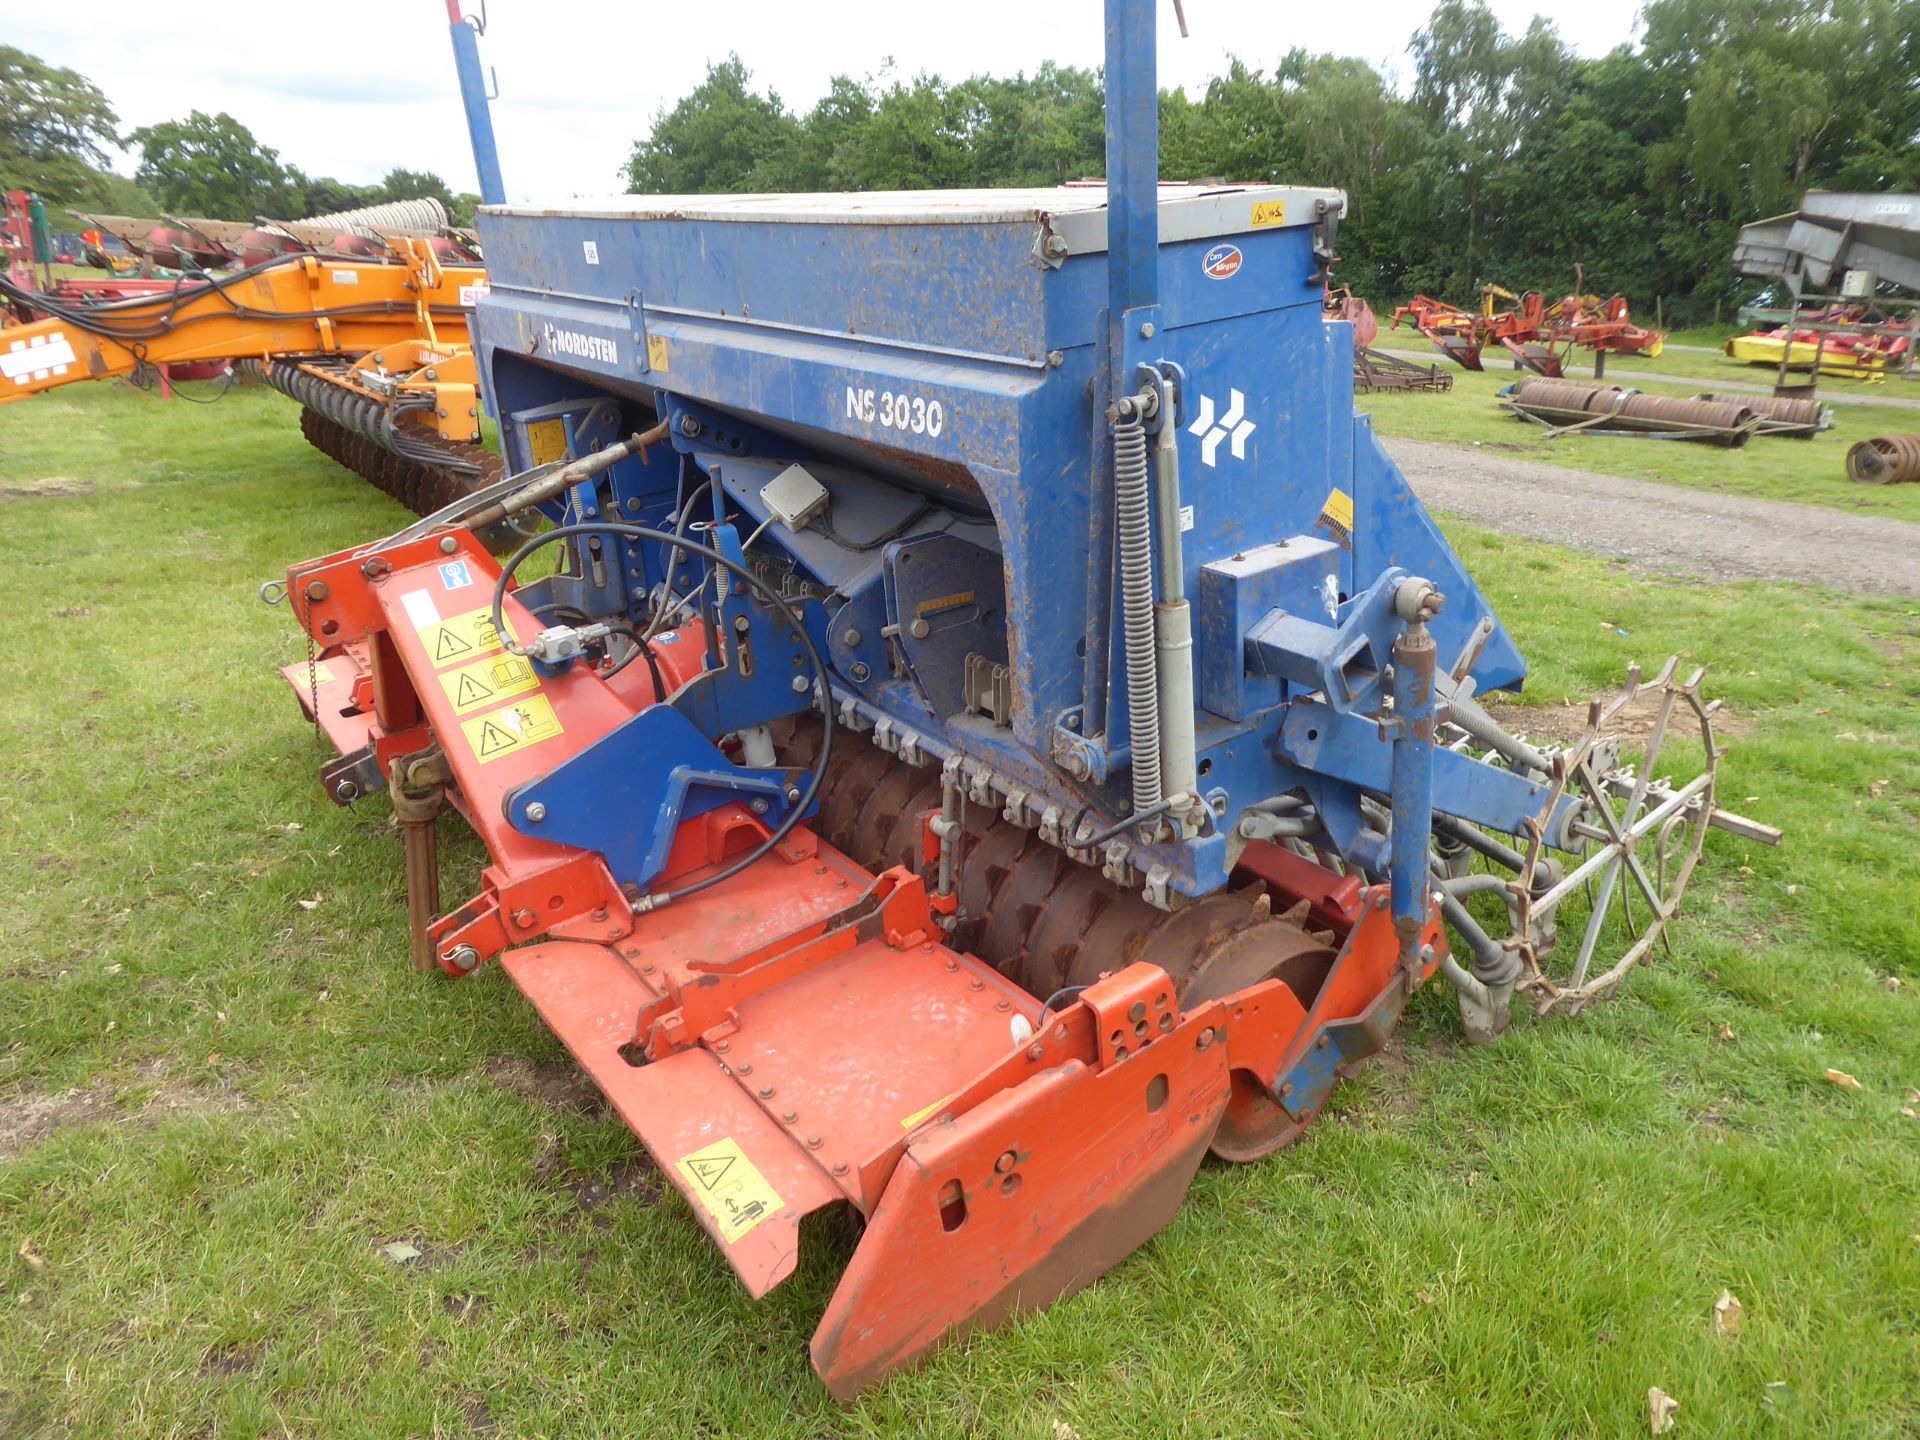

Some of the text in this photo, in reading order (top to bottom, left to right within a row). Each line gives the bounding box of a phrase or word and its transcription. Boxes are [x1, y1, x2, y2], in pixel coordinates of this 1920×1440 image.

[556, 329, 618, 365] NORDSTEN
[847, 386, 943, 438] NS 3030
